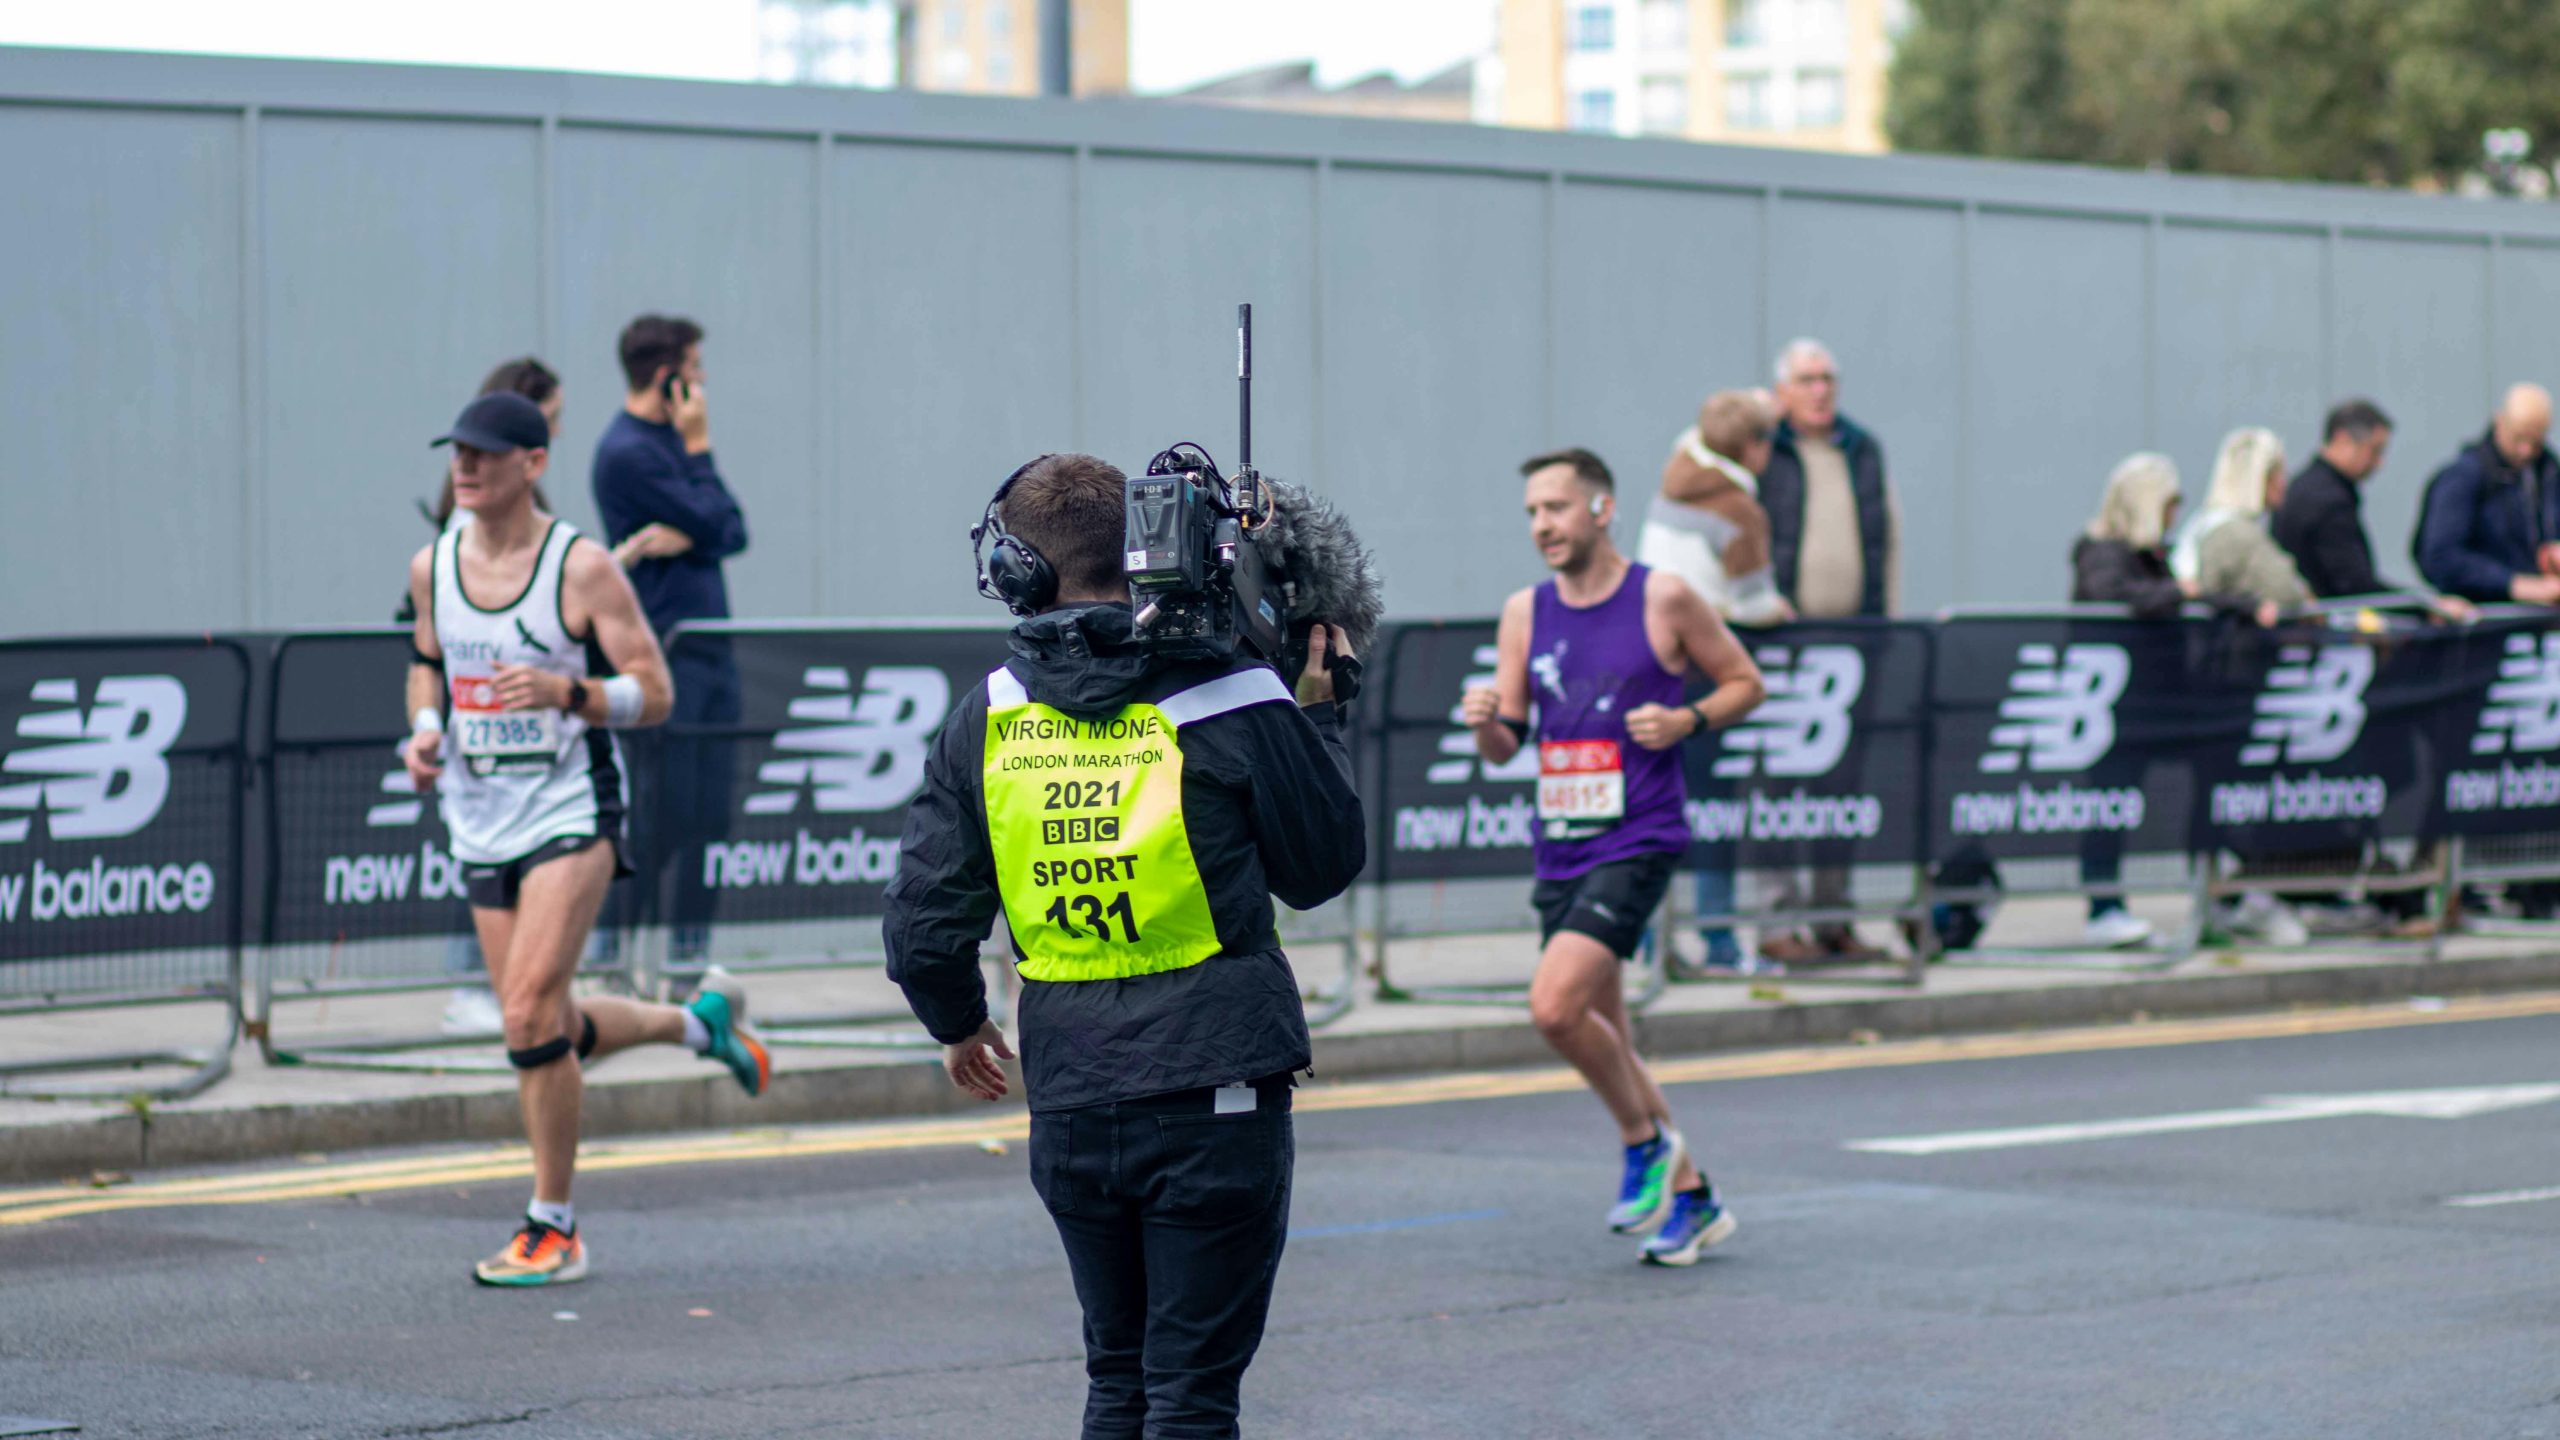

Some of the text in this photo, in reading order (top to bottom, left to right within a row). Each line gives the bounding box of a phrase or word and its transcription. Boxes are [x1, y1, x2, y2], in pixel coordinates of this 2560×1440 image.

[465, 717, 543, 747] 27385
[996, 716, 1167, 742] VIRGIN MONE
[1003, 749, 1163, 771] LONDON MARATHON
[2446, 759, 2560, 813] new bala
[1044, 781, 1121, 810] 2021
[1683, 789, 1881, 842] new balance
[1952, 782, 2145, 836] new balance
[2211, 771, 2388, 826] new balance
[1043, 817, 1119, 845] BBC
[1394, 805, 1465, 849] new
[325, 853, 416, 905] new
[704, 827, 902, 887] new bala
[1033, 854, 1138, 887] SPORT
[31, 856, 215, 921] balance
[1045, 891, 1141, 944] 131
